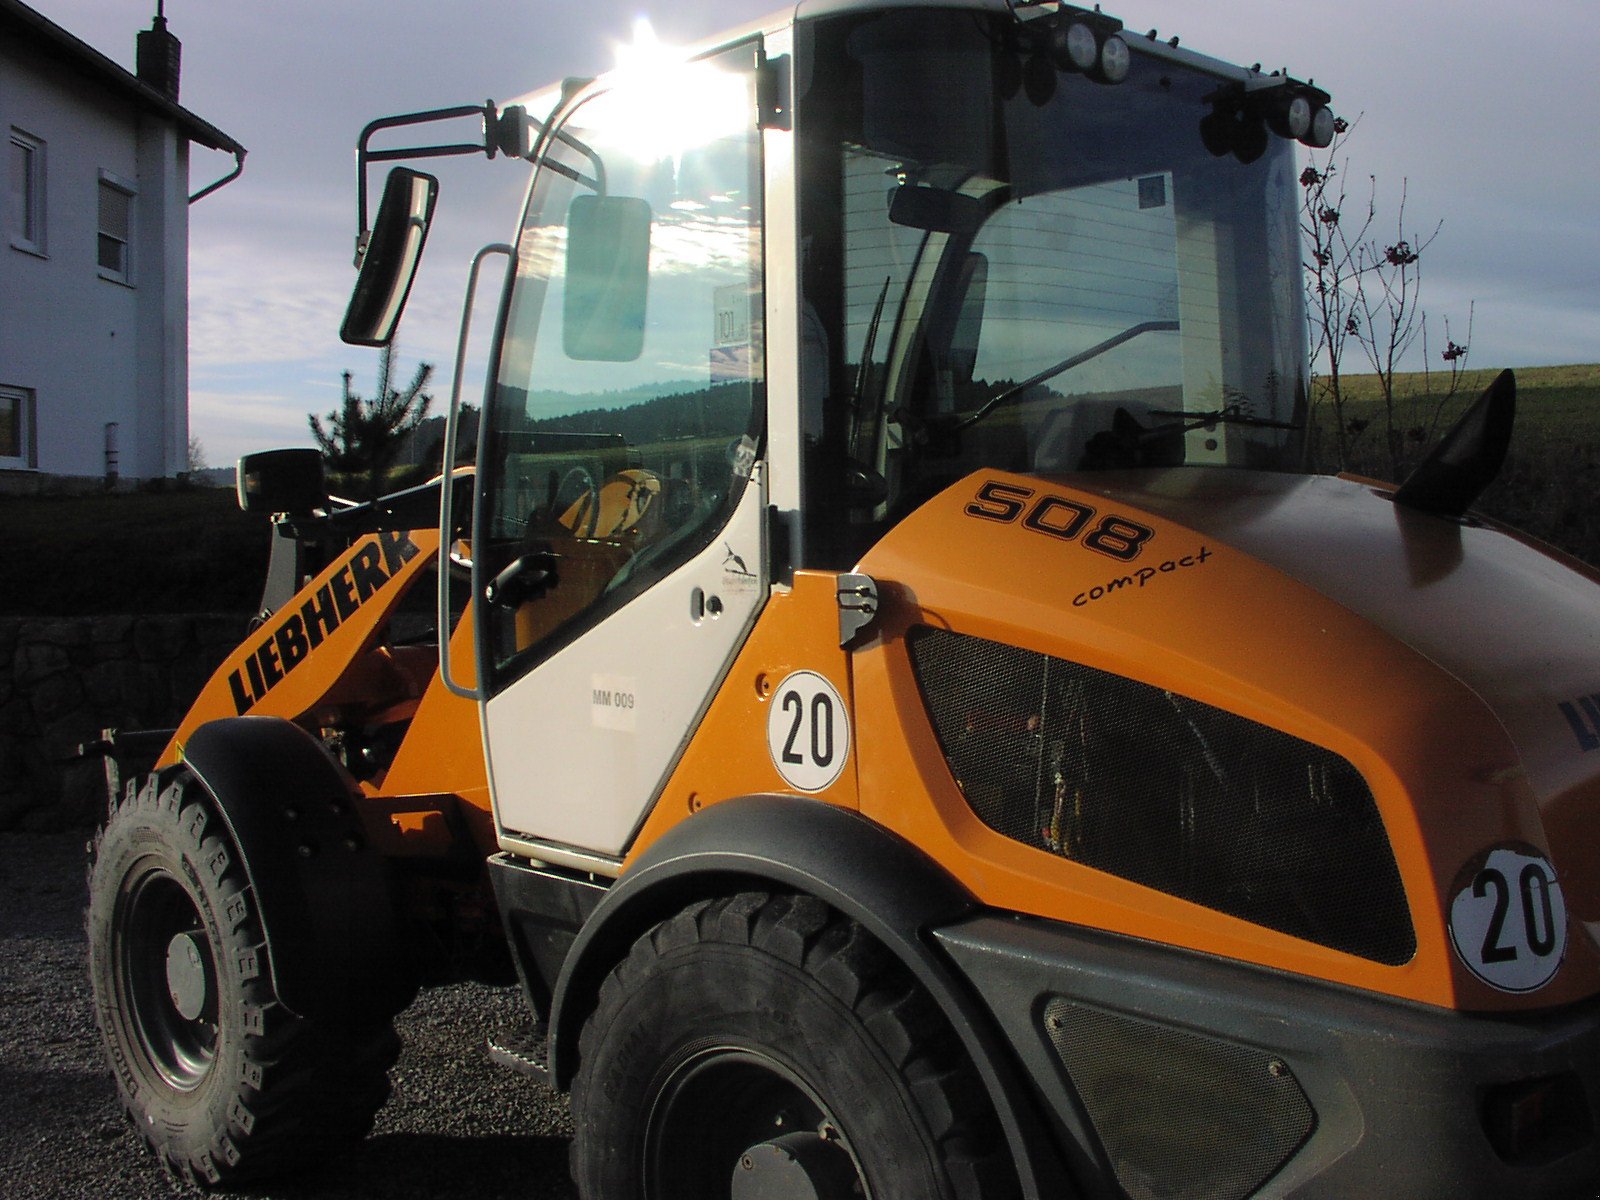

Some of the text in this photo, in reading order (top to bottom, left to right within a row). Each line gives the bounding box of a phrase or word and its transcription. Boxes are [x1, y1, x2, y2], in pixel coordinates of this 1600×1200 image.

[963, 479, 1155, 563] 508
[1072, 545, 1213, 607] compact
[592, 689, 634, 709] MM 009
[781, 690, 834, 768] 20
[1472, 863, 1556, 965] 20
